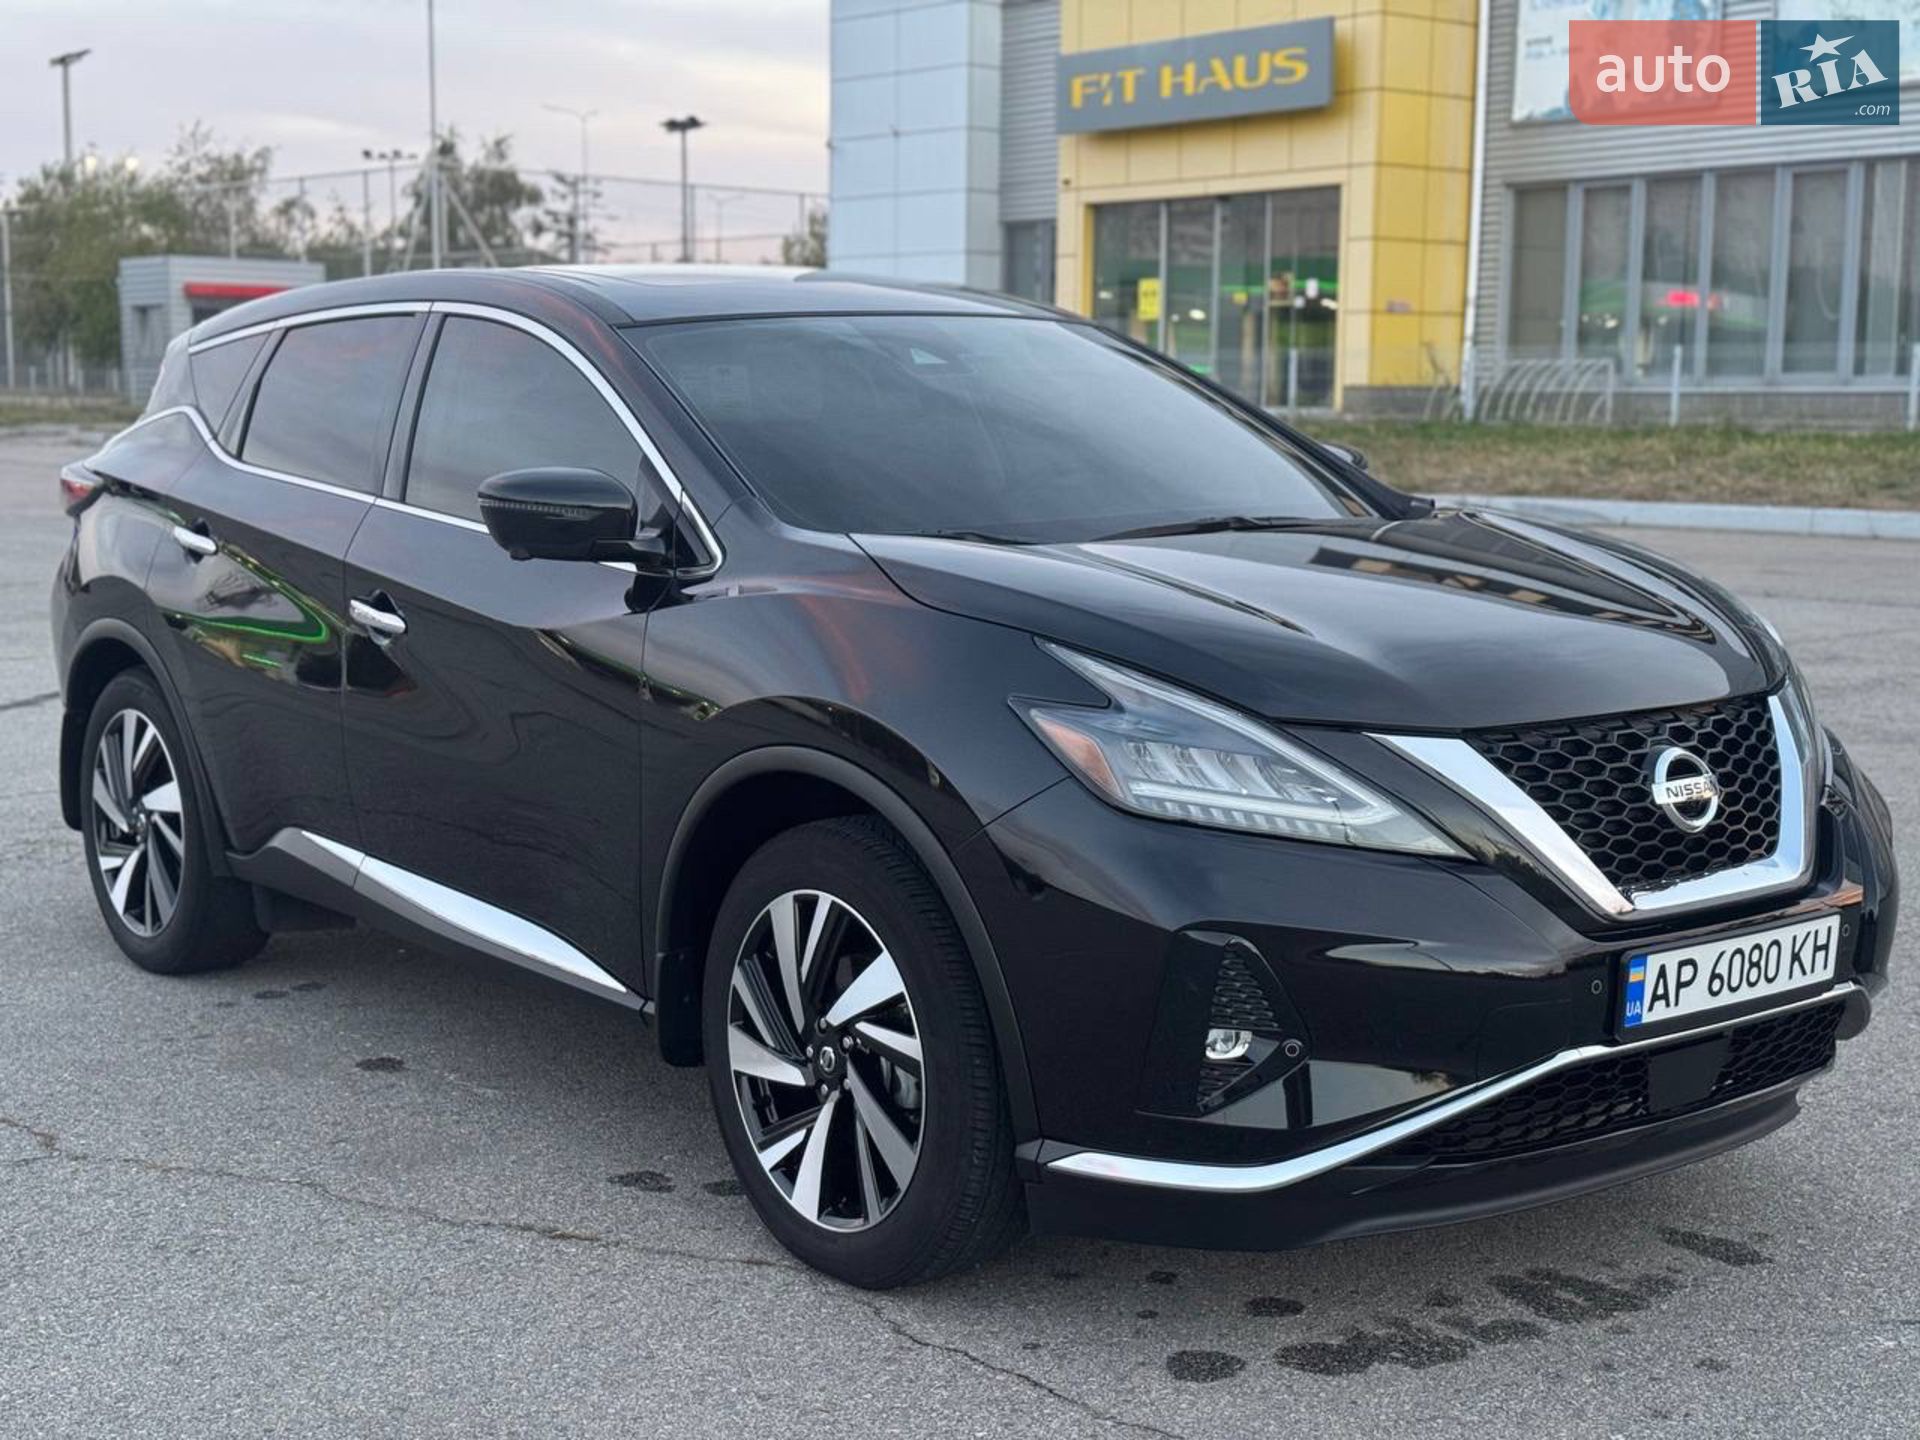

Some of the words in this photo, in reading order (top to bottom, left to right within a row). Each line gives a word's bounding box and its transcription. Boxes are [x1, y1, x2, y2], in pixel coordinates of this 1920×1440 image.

[1071, 68, 1145, 108] FIT
[1160, 48, 1308, 98] HAUS
[1648, 958, 1698, 1012] AP
[1708, 939, 1782, 997] 6080
[1789, 925, 1832, 980] KH
[1626, 1001, 1641, 1016] UA
